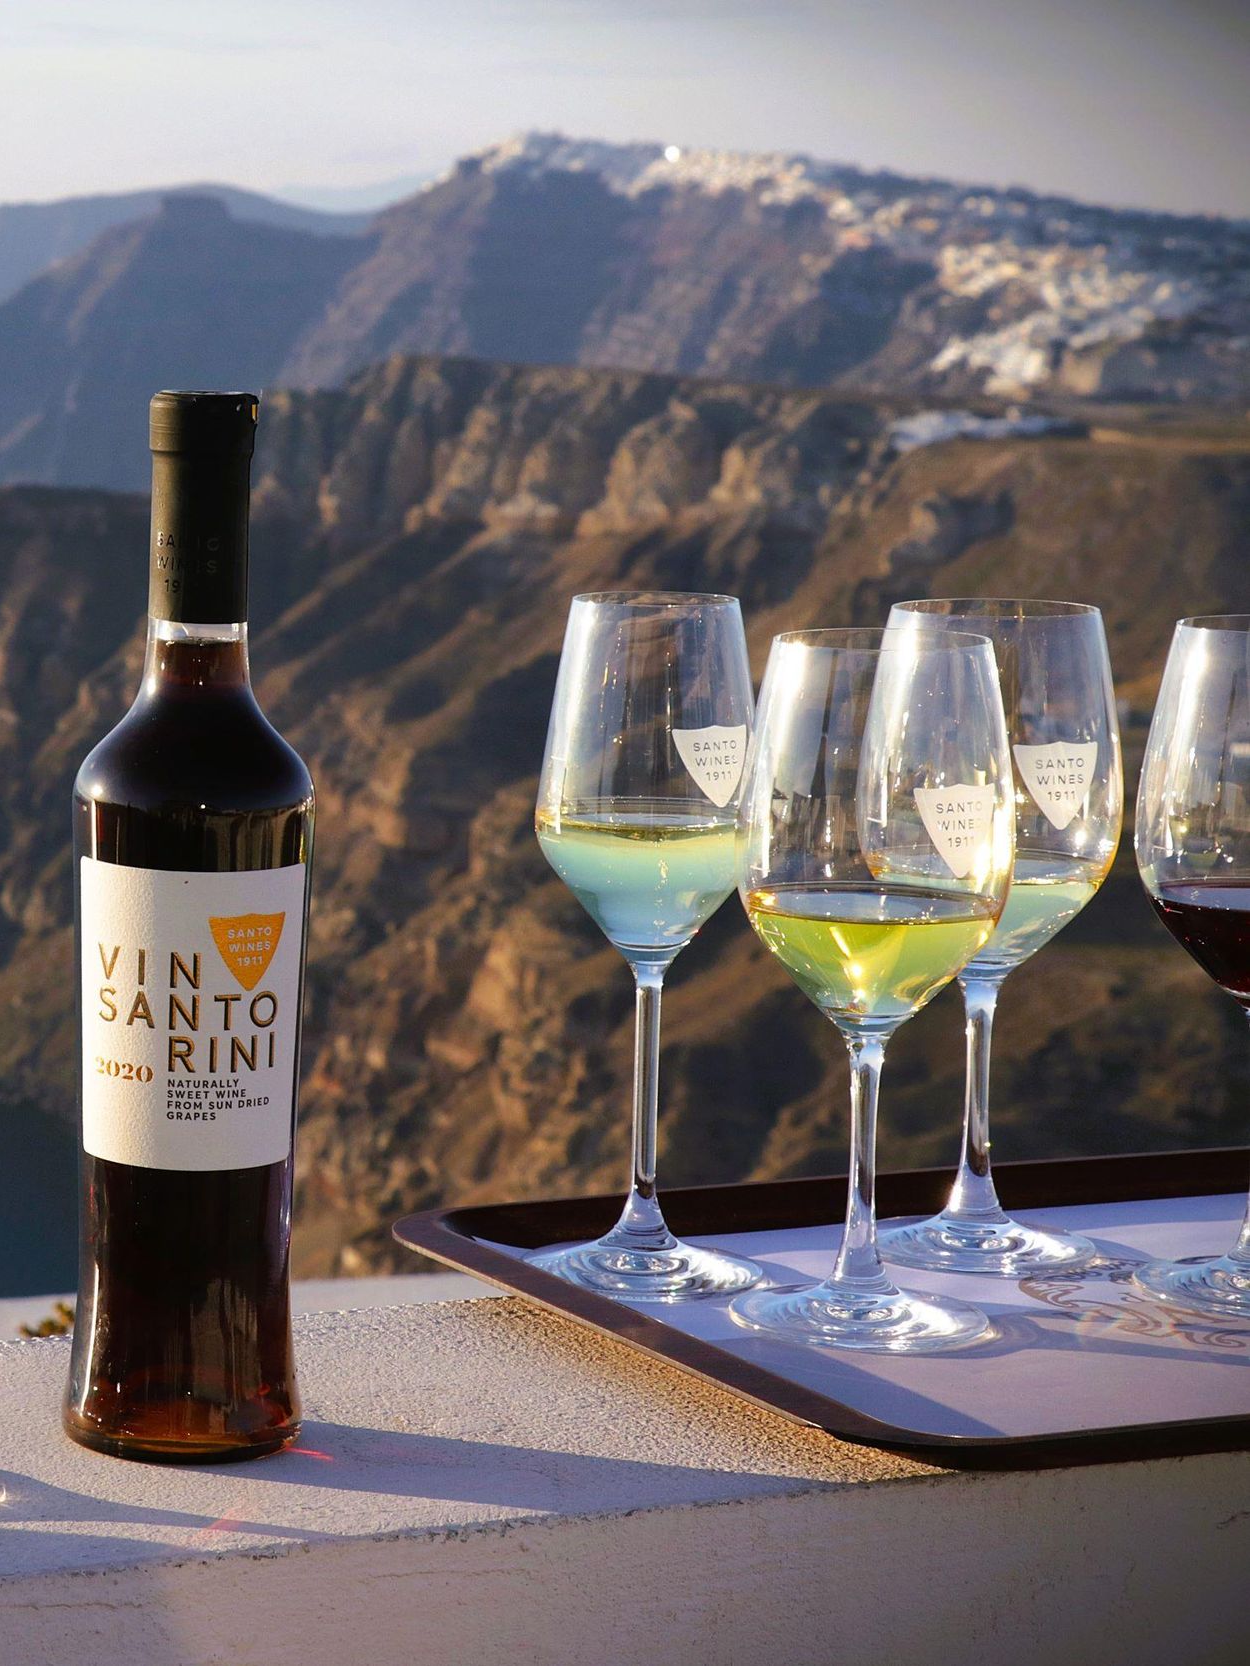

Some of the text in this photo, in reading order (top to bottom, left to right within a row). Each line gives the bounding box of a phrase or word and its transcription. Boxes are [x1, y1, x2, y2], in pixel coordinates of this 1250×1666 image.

[693, 740, 737, 752] SANTO
[1035, 758, 1085, 769] SANTO
[706, 771, 732, 781] 1911
[1036, 774, 1084, 785] WINES
[1047, 791, 1076, 801] 1911
[937, 818, 980, 831] WINE
[228, 926, 272, 939] SANTO
[228, 940, 271, 953] WINES
[98, 941, 201, 989] VIN
[237, 956, 263, 967] 1911
[98, 985, 279, 1032] SANTO
[167, 1031, 275, 1074] RINI
[94, 1056, 154, 1084] 2020
[167, 1079, 240, 1089] NATURALLY
[167, 1088, 247, 1099] SWEET WINE
[167, 1096, 270, 1110] FROM SUN DRIED
[167, 1111, 217, 1121] GRAPES
